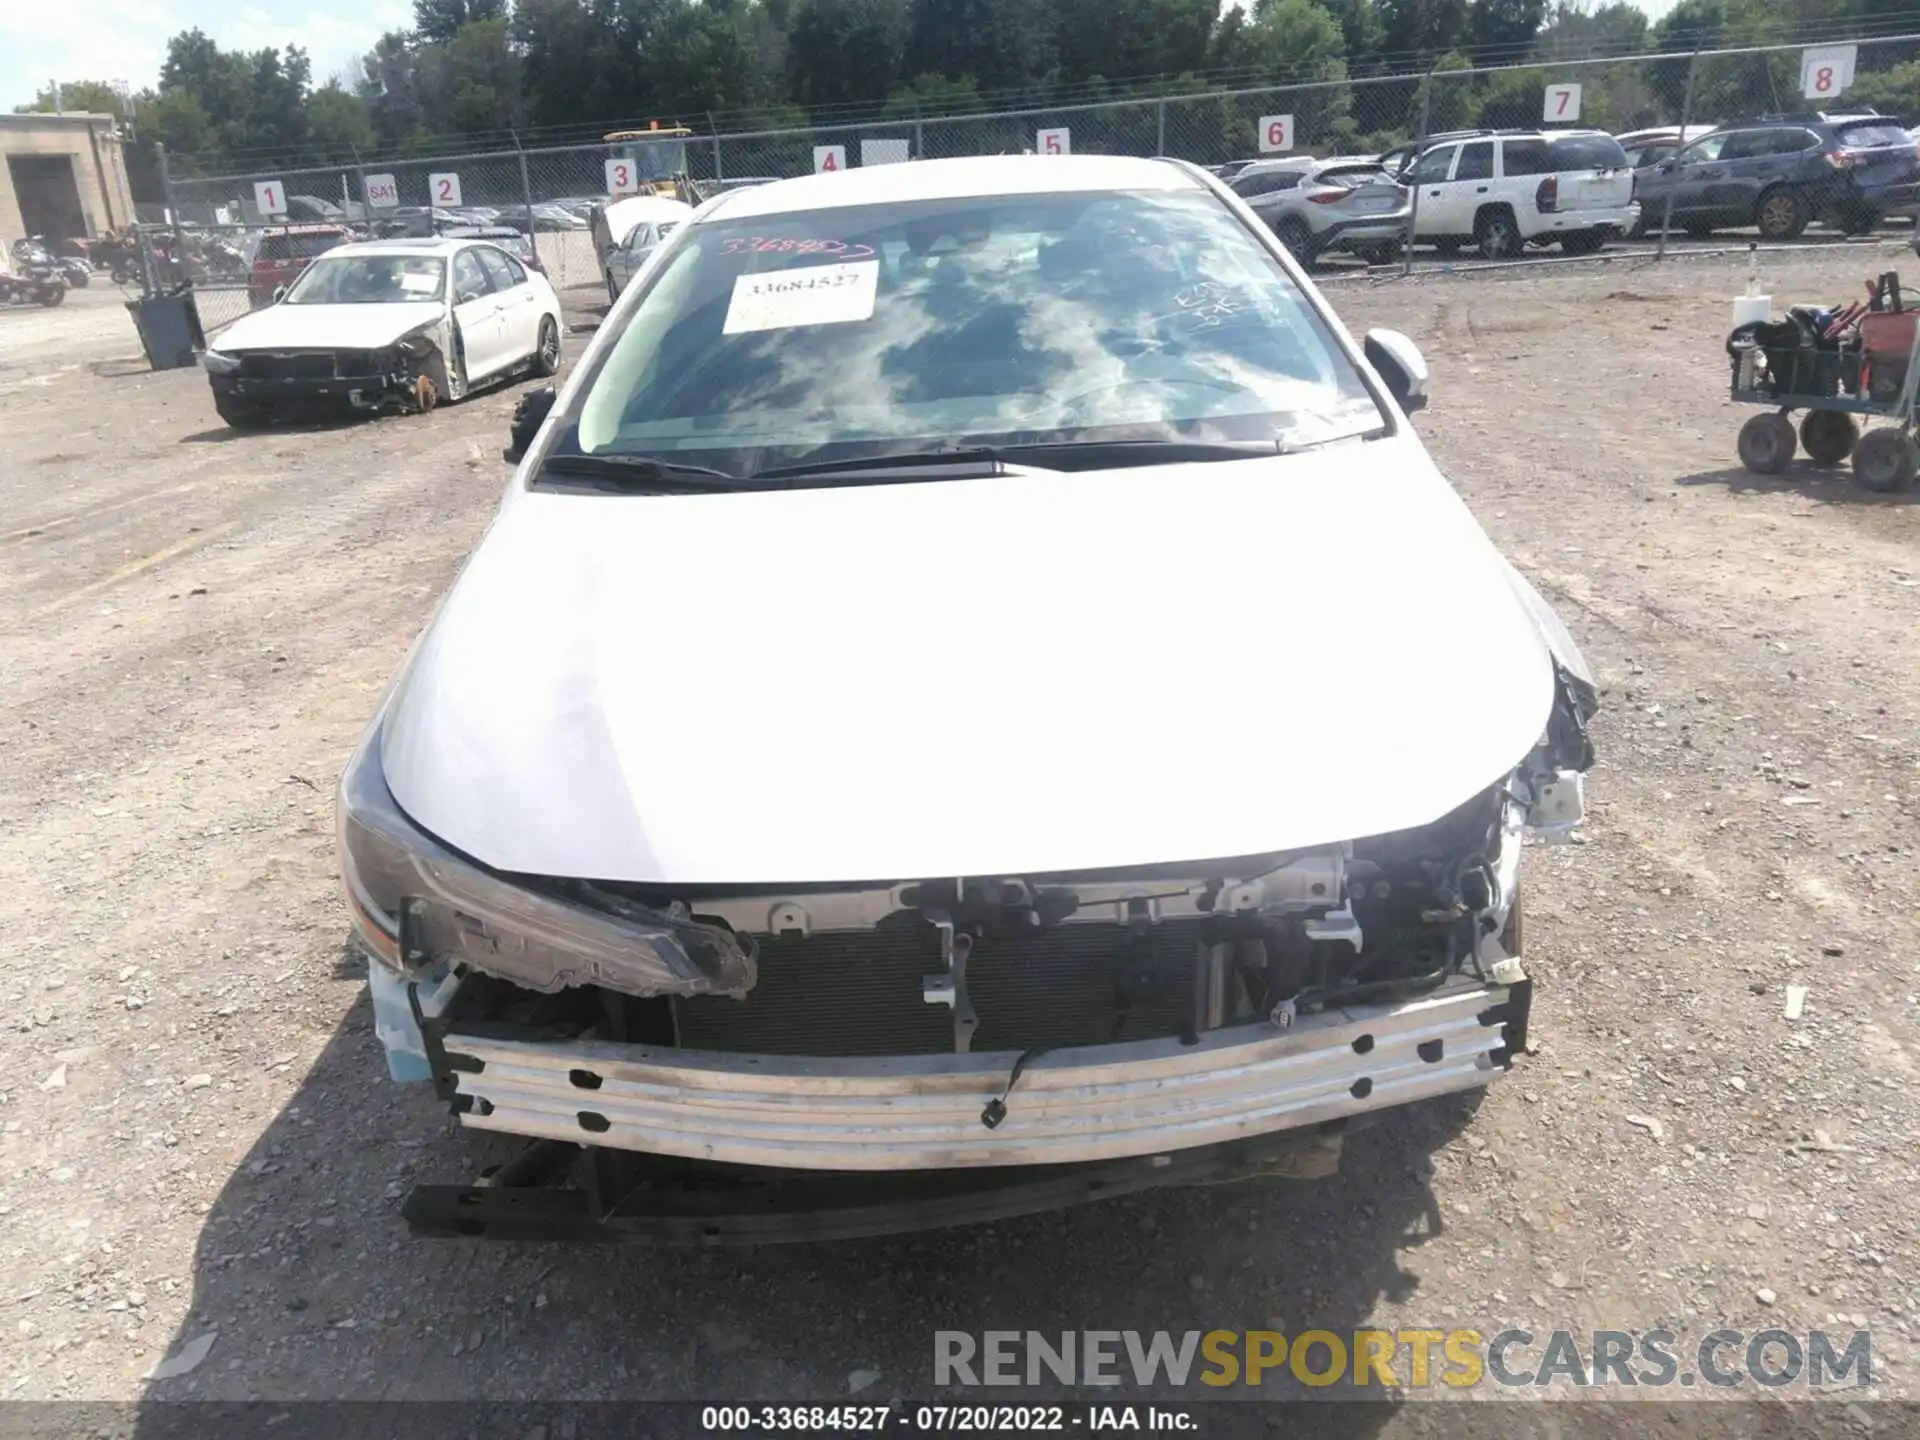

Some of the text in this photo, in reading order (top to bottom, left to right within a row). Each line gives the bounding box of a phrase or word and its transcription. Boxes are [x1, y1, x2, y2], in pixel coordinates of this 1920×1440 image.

[1815, 67, 1833, 92] 8
[1555, 91, 1571, 115] 7
[1046, 134, 1061, 155] 5
[1267, 122, 1284, 146] 6
[822, 151, 838, 172] 4
[613, 165, 629, 188] 3
[264, 187, 276, 209] 1
[370, 184, 396, 199] SA1
[437, 179, 454, 201] 2
